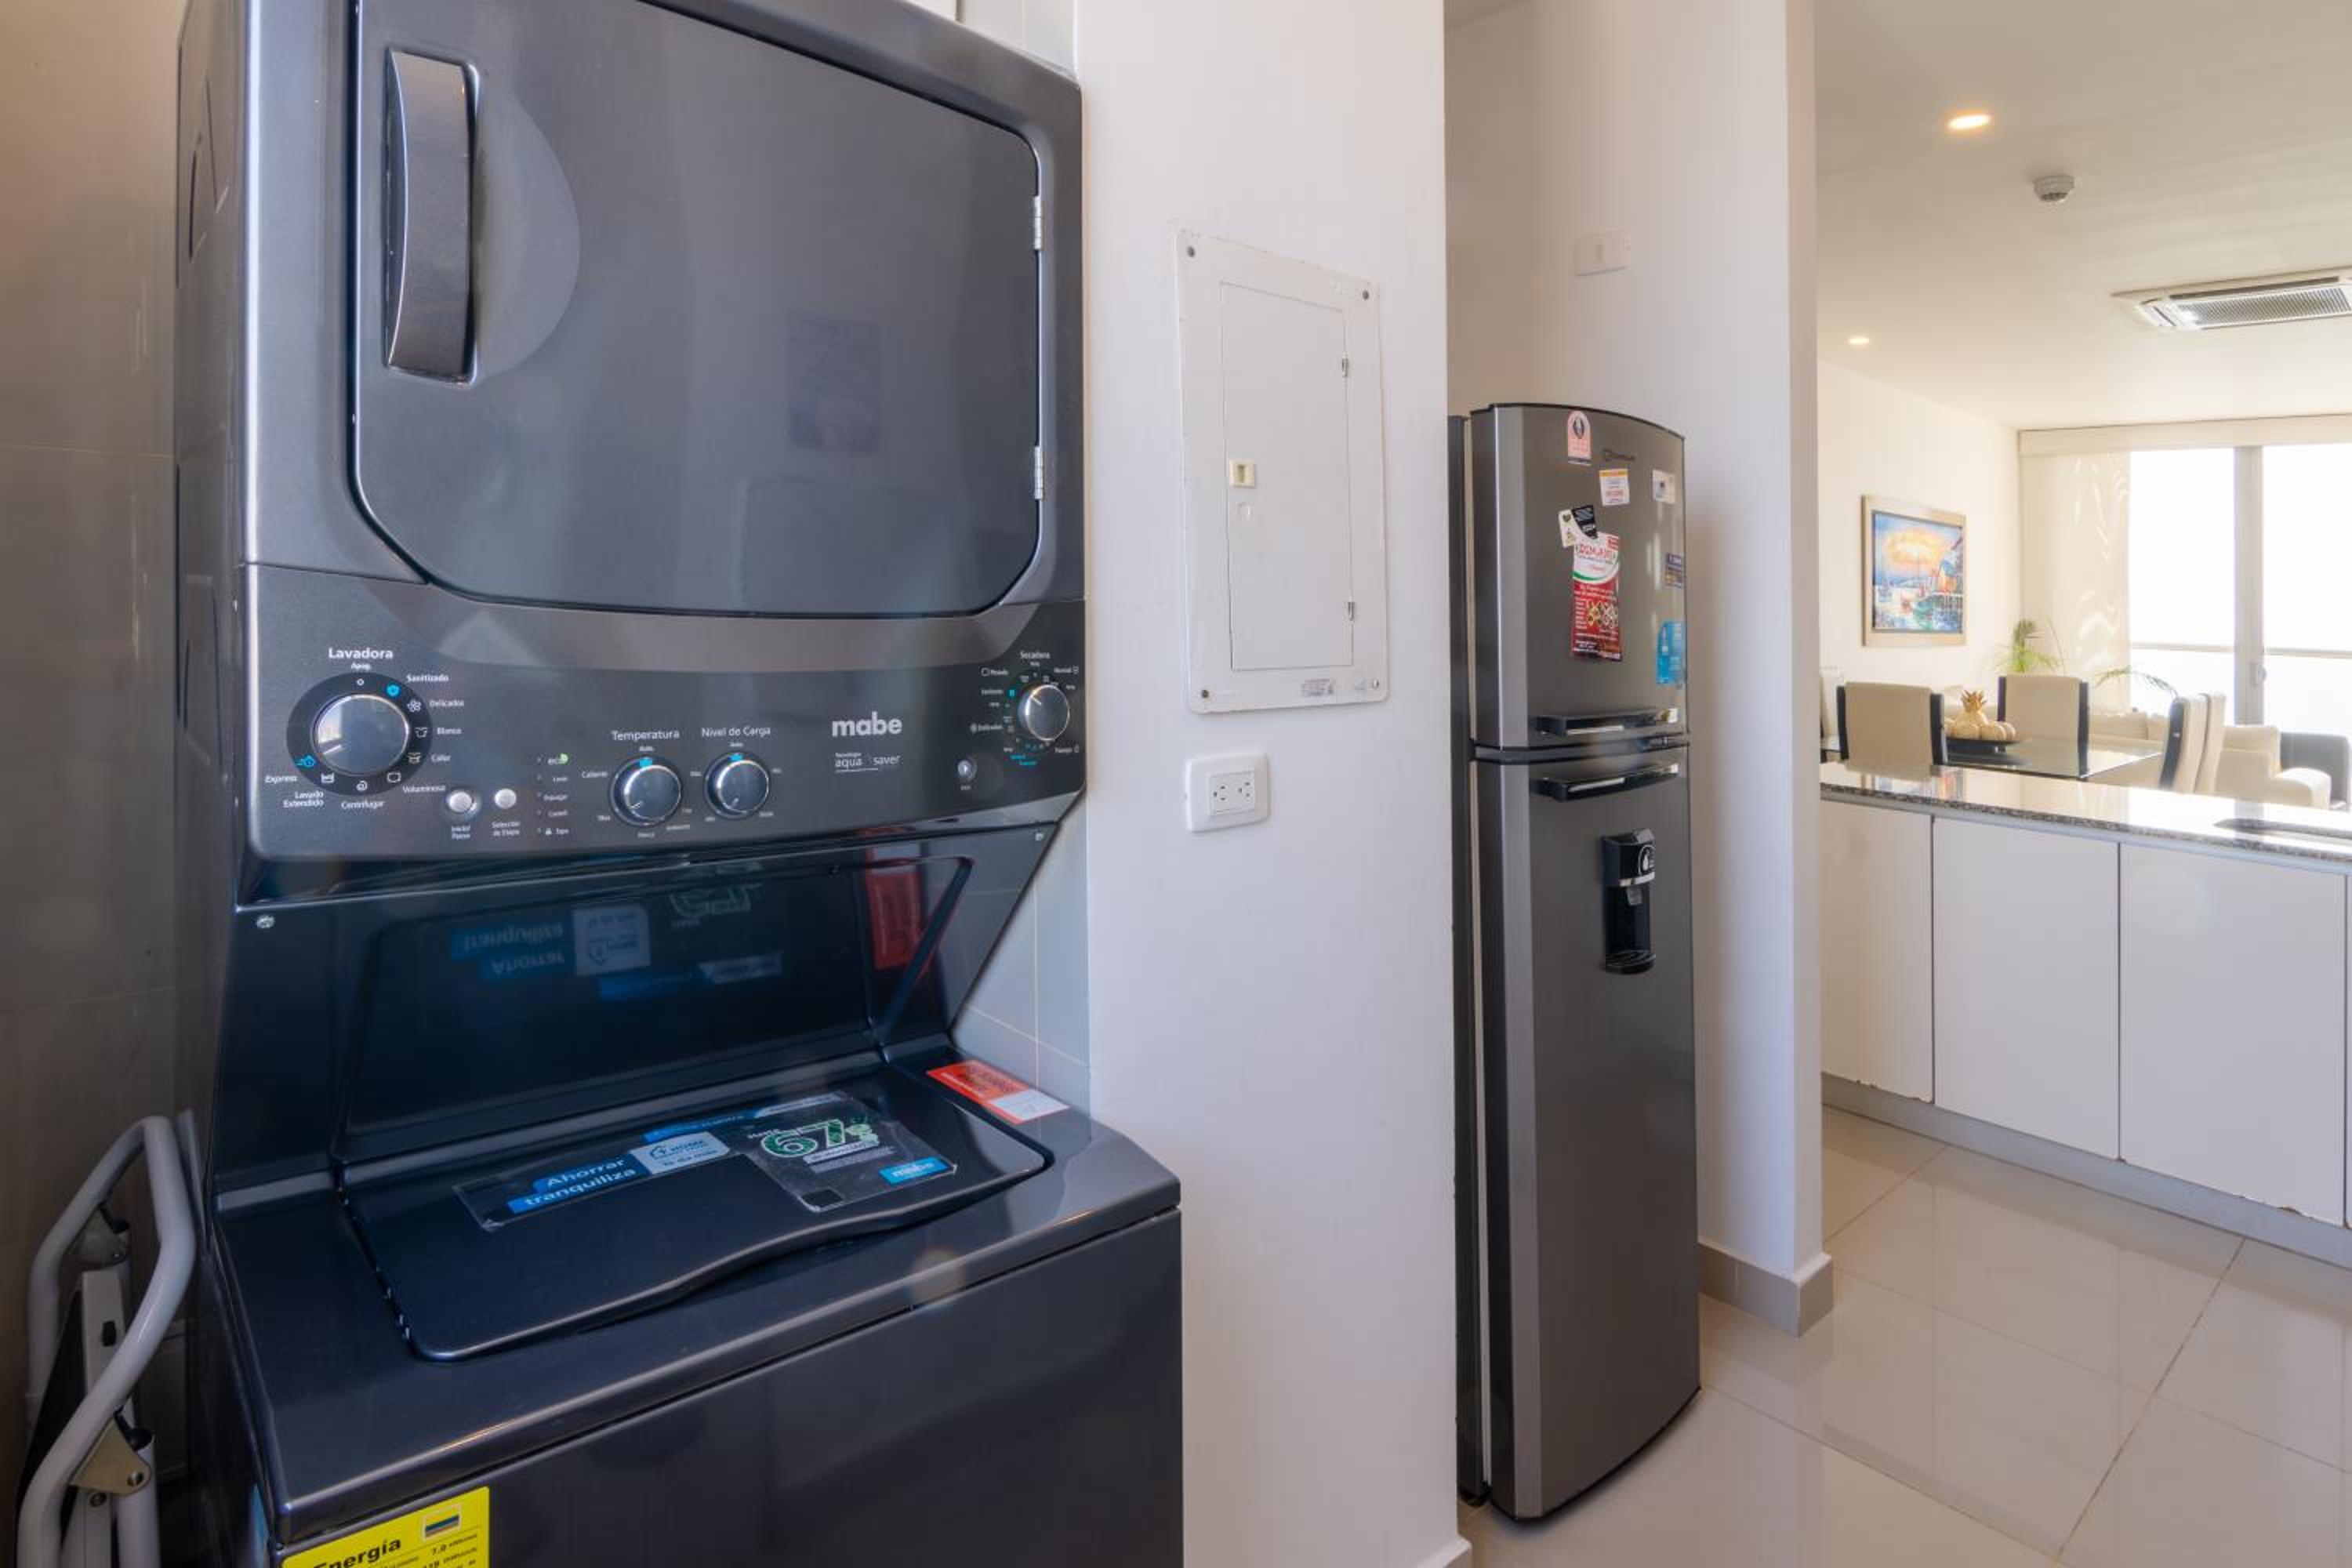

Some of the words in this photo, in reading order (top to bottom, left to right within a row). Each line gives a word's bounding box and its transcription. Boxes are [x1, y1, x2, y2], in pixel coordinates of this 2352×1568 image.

[328, 647, 394, 659] Lavadora
[405, 673, 450, 683] Sanitizado
[832, 710, 902, 738] mabe
[611, 729, 681, 742] Temperatura
[702, 727, 726, 737] Nivel
[728, 726, 742, 736] de
[742, 724, 771, 738] Carga
[835, 757, 862, 770] aqua
[873, 755, 901, 766] saver
[294, 789, 325, 799] Lavado
[283, 798, 325, 808] Extendido
[340, 800, 386, 810] Centrifugar
[547, 1158, 626, 1188] Ahorrar
[524, 1168, 637, 1206] tranquiliza
